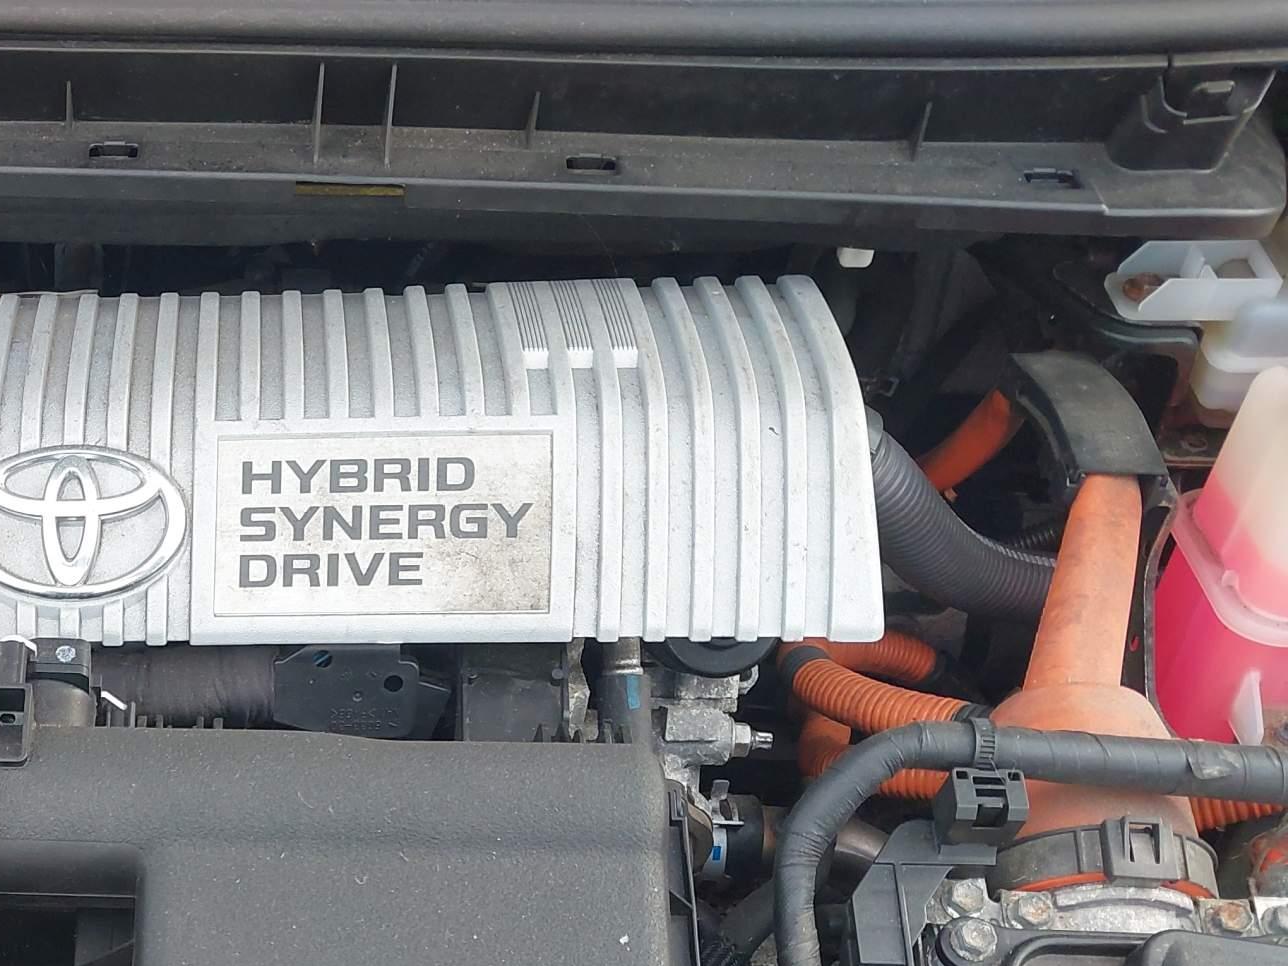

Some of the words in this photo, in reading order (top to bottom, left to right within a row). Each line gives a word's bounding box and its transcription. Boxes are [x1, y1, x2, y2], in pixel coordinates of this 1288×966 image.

[241, 456, 475, 494] HYBRID
[239, 502, 534, 542] SYNERGY
[238, 551, 424, 588] DRIVE
